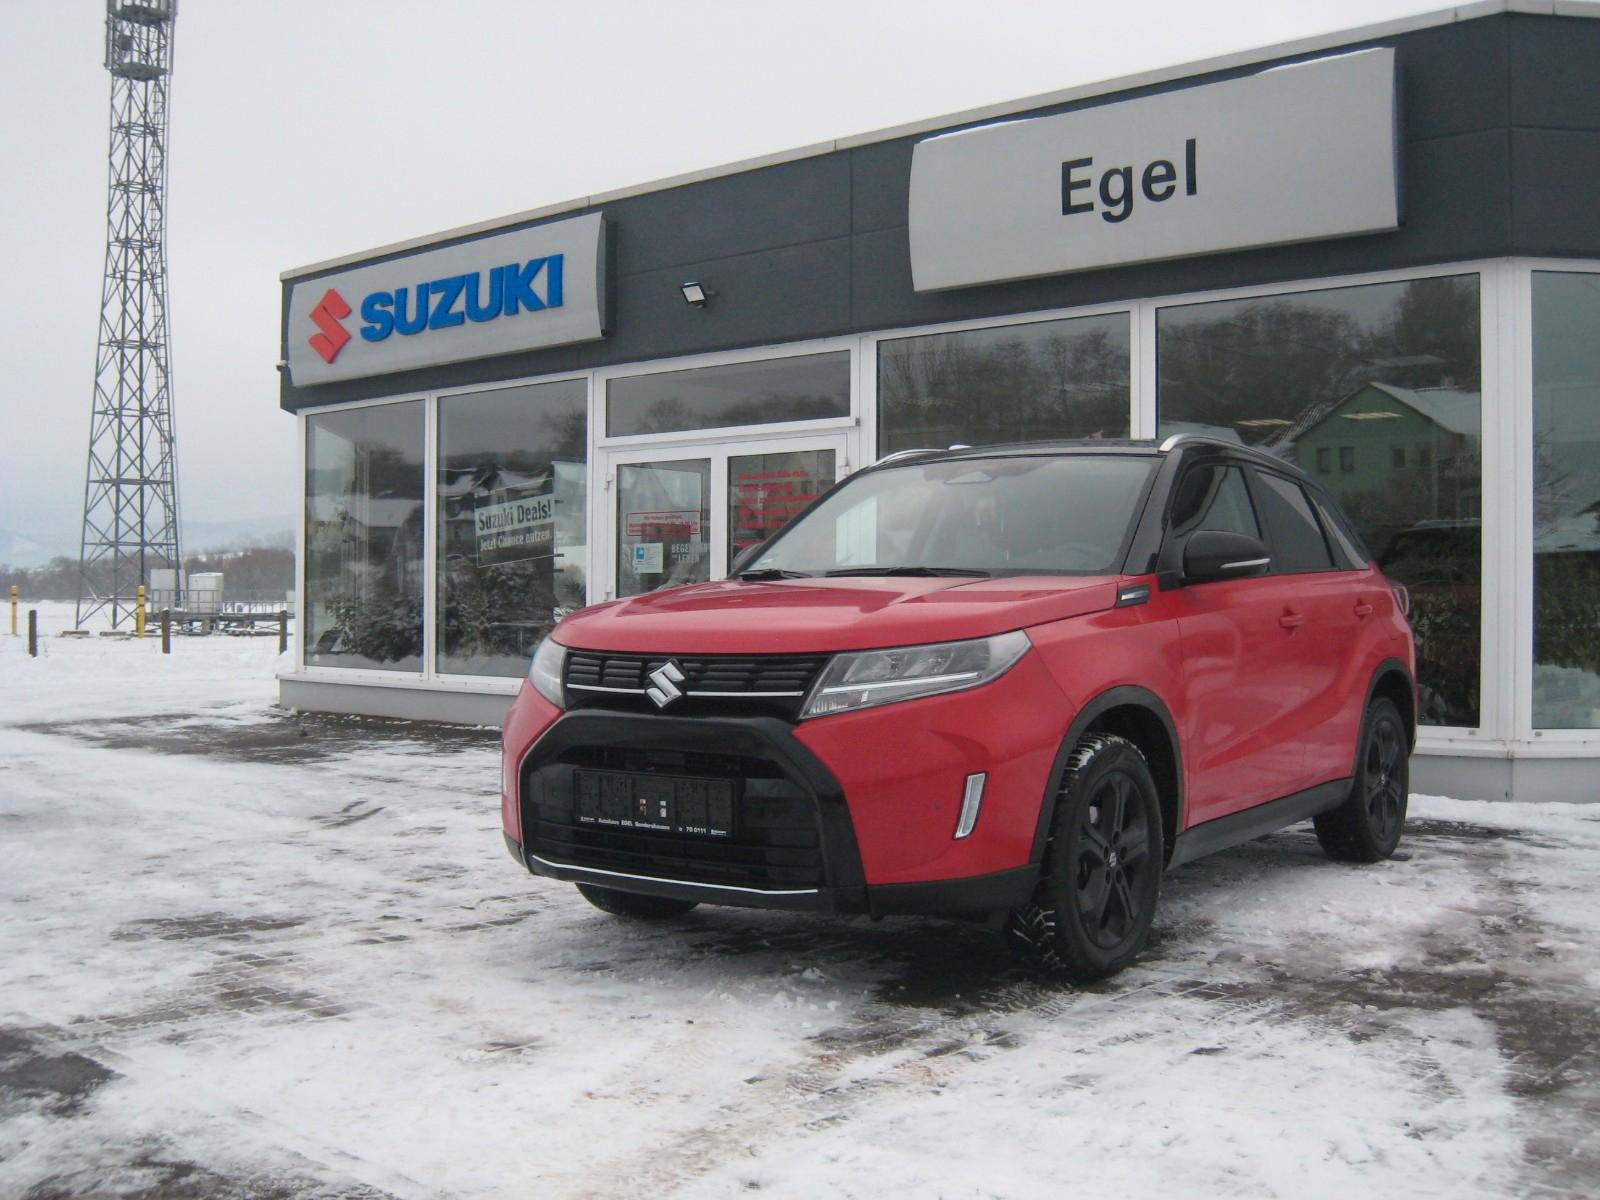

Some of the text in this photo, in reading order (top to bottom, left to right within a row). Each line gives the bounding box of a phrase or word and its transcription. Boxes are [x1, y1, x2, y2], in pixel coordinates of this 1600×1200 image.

[1061, 138, 1198, 223] Egel
[360, 254, 563, 342] SUZUKI
[479, 500, 552, 531] Suzuki Deals!
